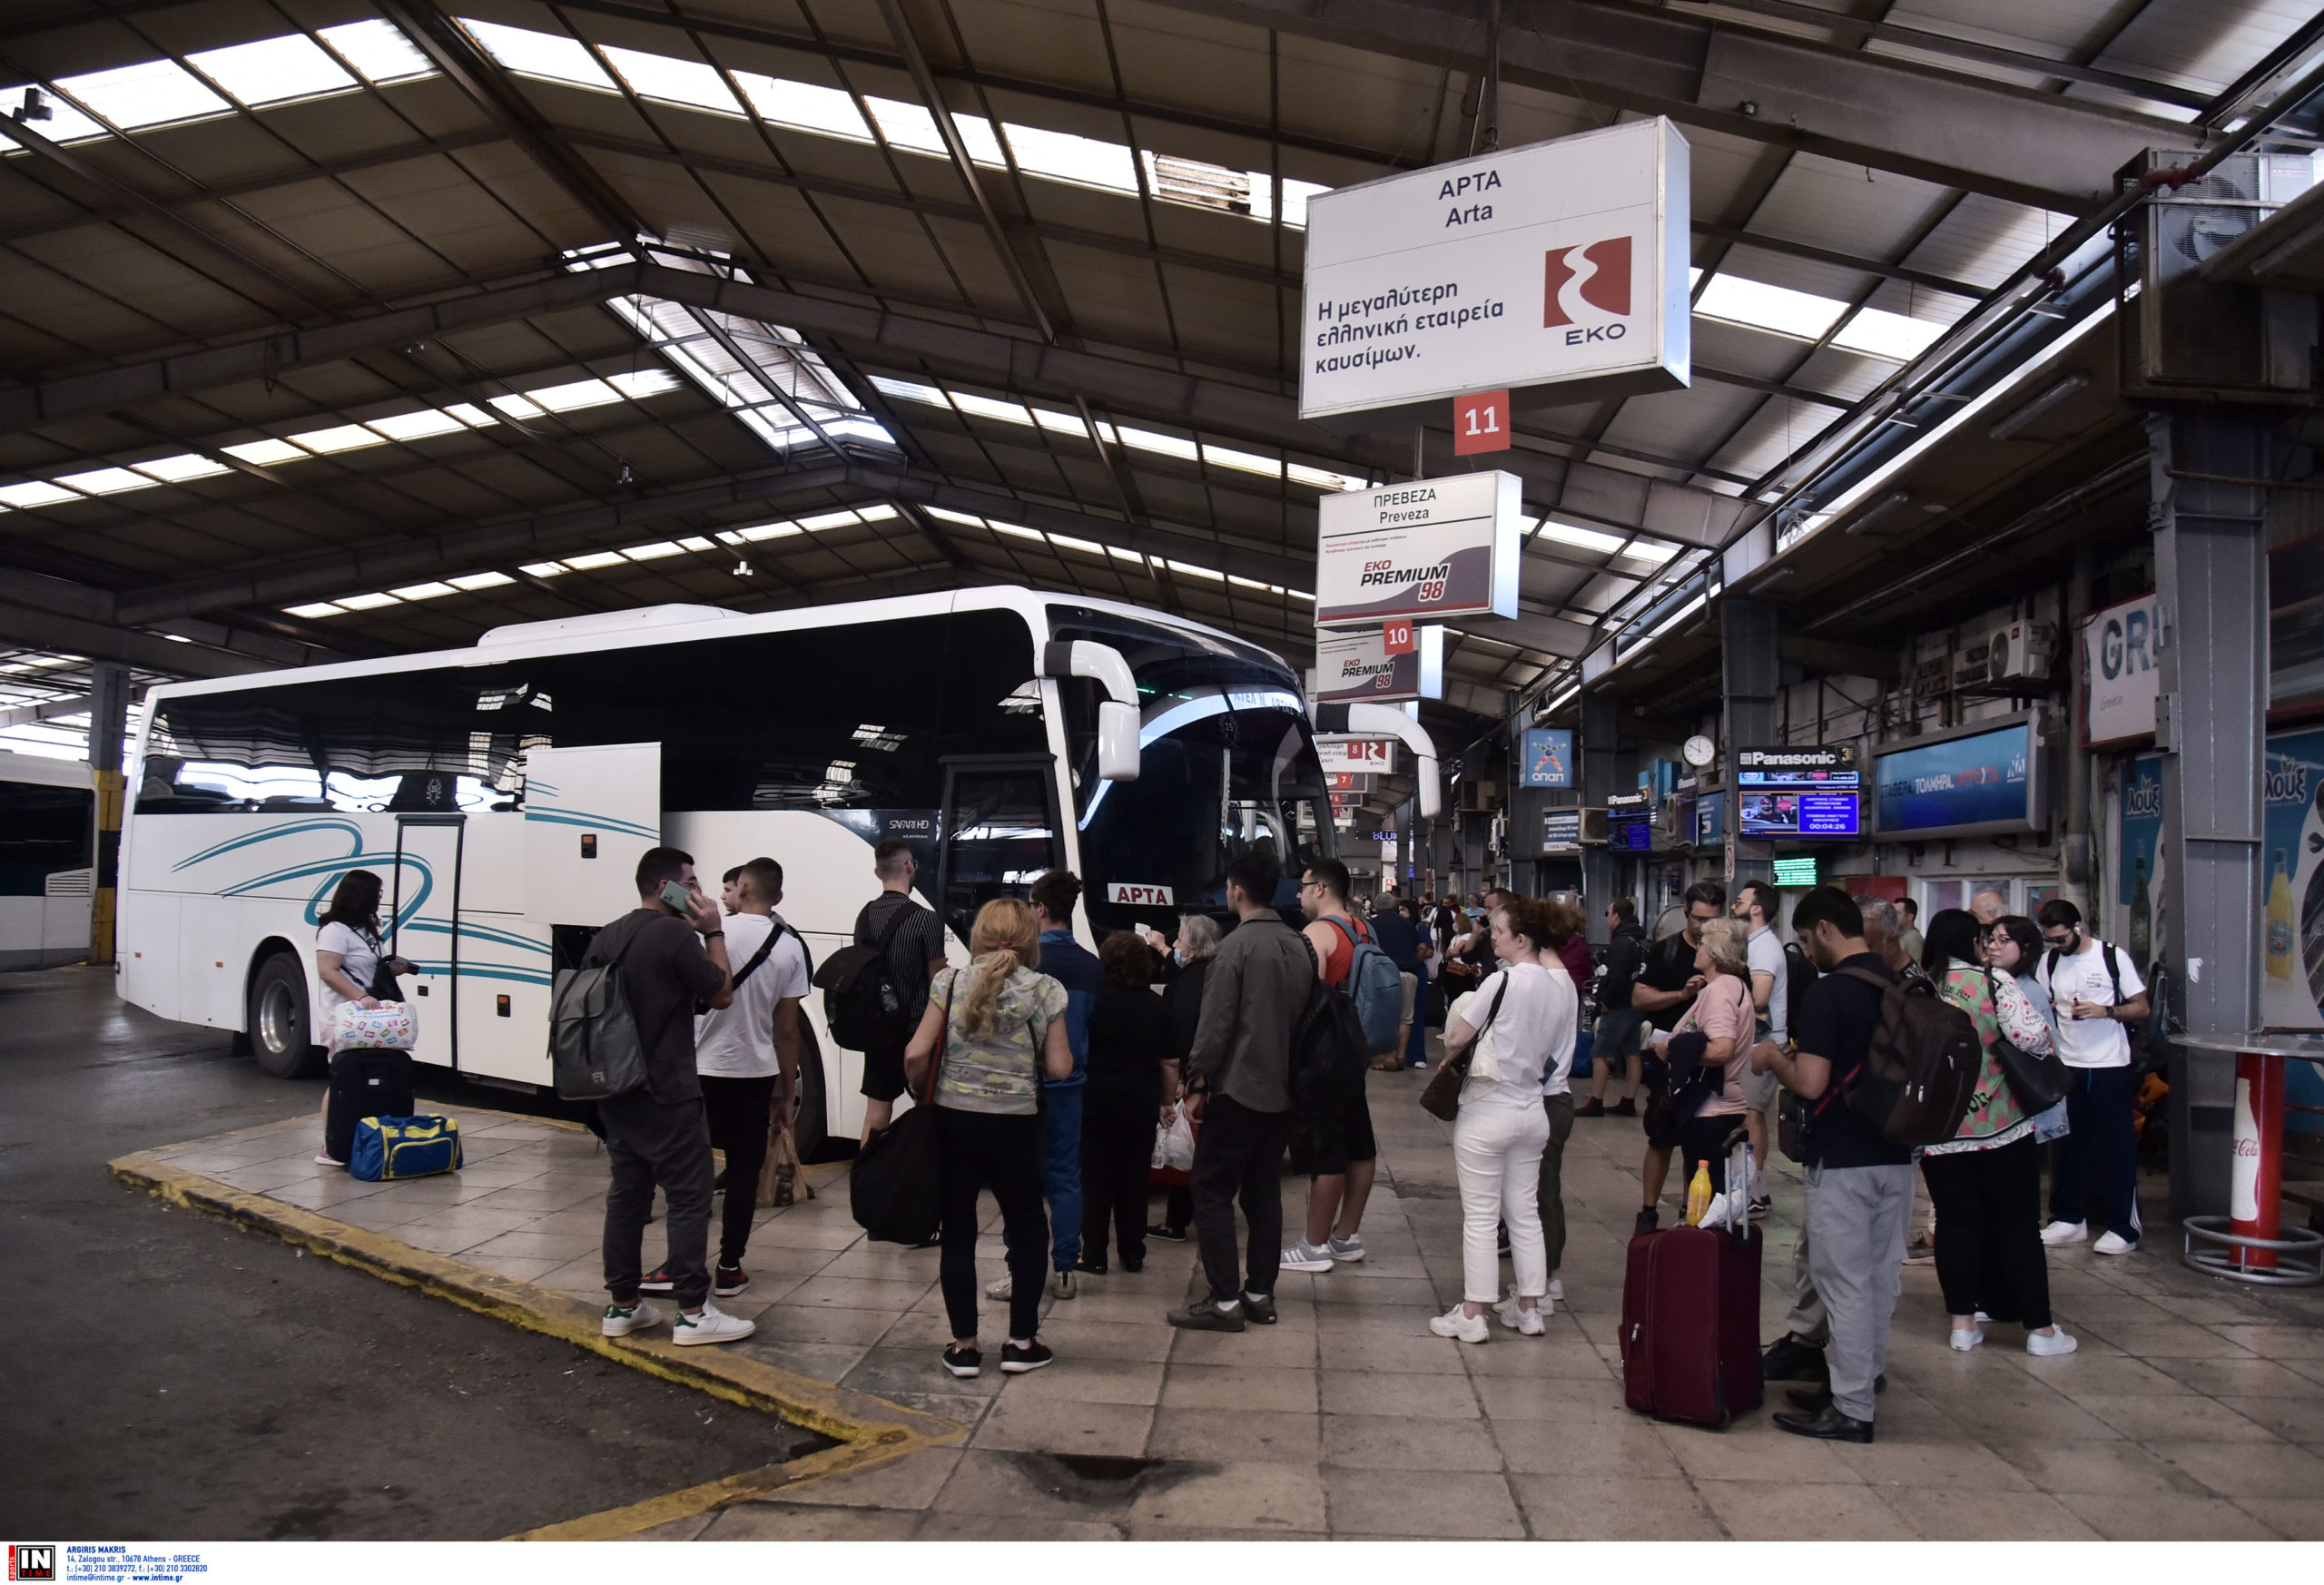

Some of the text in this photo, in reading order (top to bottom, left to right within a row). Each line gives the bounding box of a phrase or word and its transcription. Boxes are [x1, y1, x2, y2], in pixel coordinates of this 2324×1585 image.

[1439, 171, 1502, 200] ΑΡΤΑ
[1445, 203, 1492, 228] Arta
[1318, 281, 1458, 320] Η μεγαλύτερη
[1317, 300, 1503, 347] ελληνική εταιρεία
[1565, 323, 1626, 346] EKO
[1315, 343, 1421, 374] καυσίμων.
[1465, 406, 1499, 436] 11
[1374, 488, 1436, 507] ΠΡΕΒΕΖΑ
[1380, 509, 1429, 524] Preveza
[1361, 565, 1448, 586] PREMIUM
[1364, 560, 1392, 572] EKO
[1419, 581, 1444, 600] 98
[1388, 628, 1407, 645] 10
[2101, 610, 2158, 681] GR
[1342, 664, 1393, 677] PREMIUM
[1344, 659, 1360, 667] EKO
[1377, 674, 1392, 687] 98
[1353, 745, 1358, 753] 8
[1752, 751, 1836, 765] Panasonic
[1342, 775, 1346, 783] 7
[890, 820, 929, 829] SAFARI HD
[1117, 887, 1168, 906] ΑΡΤΑ
